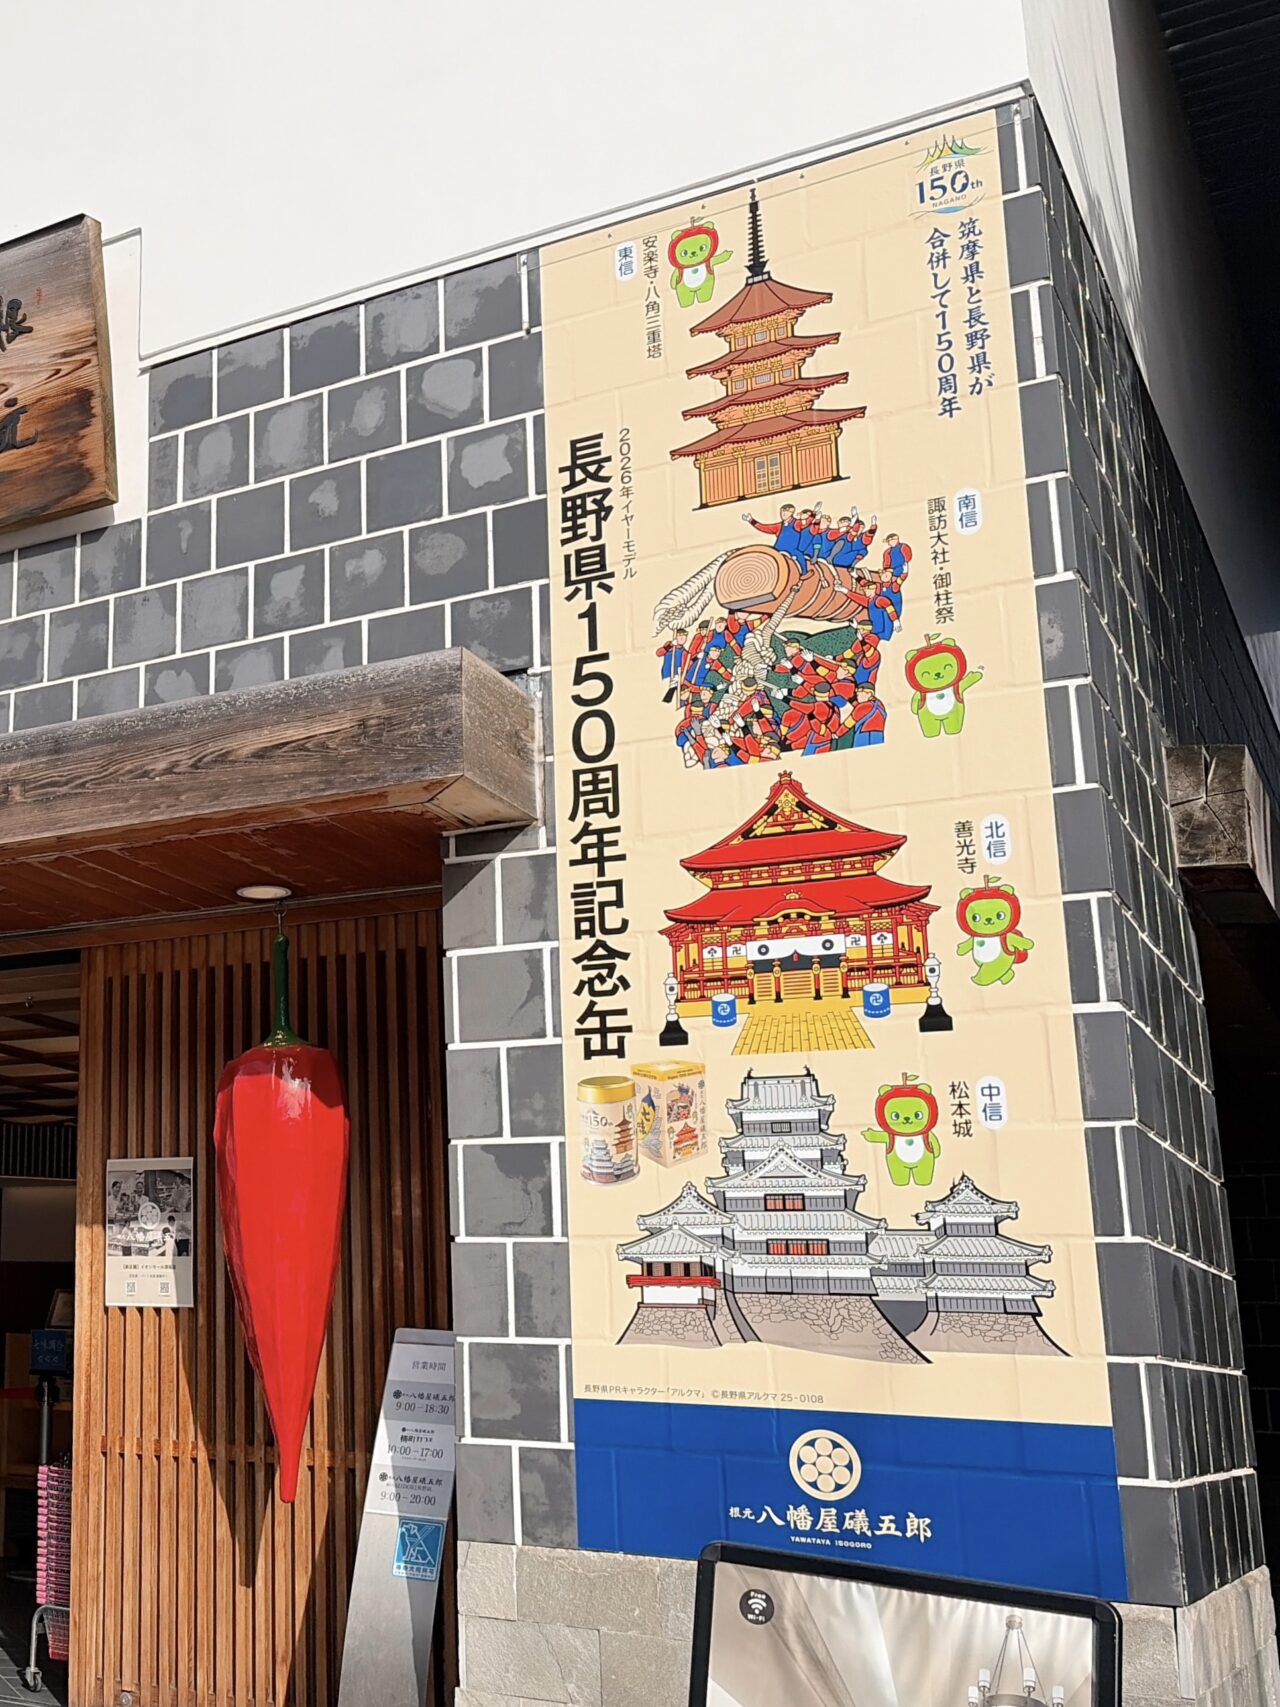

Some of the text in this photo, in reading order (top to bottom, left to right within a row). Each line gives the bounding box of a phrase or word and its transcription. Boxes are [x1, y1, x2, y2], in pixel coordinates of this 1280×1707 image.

[915, 170, 983, 204] 150th
[929, 159, 966, 177] 長野県
[932, 193, 967, 208] NAGANO
[617, 245, 635, 277] 東信
[642, 235, 662, 360] 安楽寺・八角三重塔
[957, 217, 995, 396] 筑摩県と長野県が
[924, 227, 962, 419] 合併して150周年
[618, 428, 638, 580] 2026年イヤーモデル
[956, 494, 978, 529] 南信
[927, 496, 955, 624] 諏訪大社・御柱祭
[557, 432, 633, 1060] 長野県150周年記念缶
[954, 820, 977, 874] 善光寺
[984, 820, 1007, 859] 北信
[948, 1081, 973, 1138] 松本城
[981, 1083, 1002, 1122] 中信
[412, 1360, 447, 1372] 営業時間
[790, 1535, 831, 1546] YAWATAYA
[750, 1591, 766, 1600] Free
[747, 1613, 765, 1622] Wi-Fi
